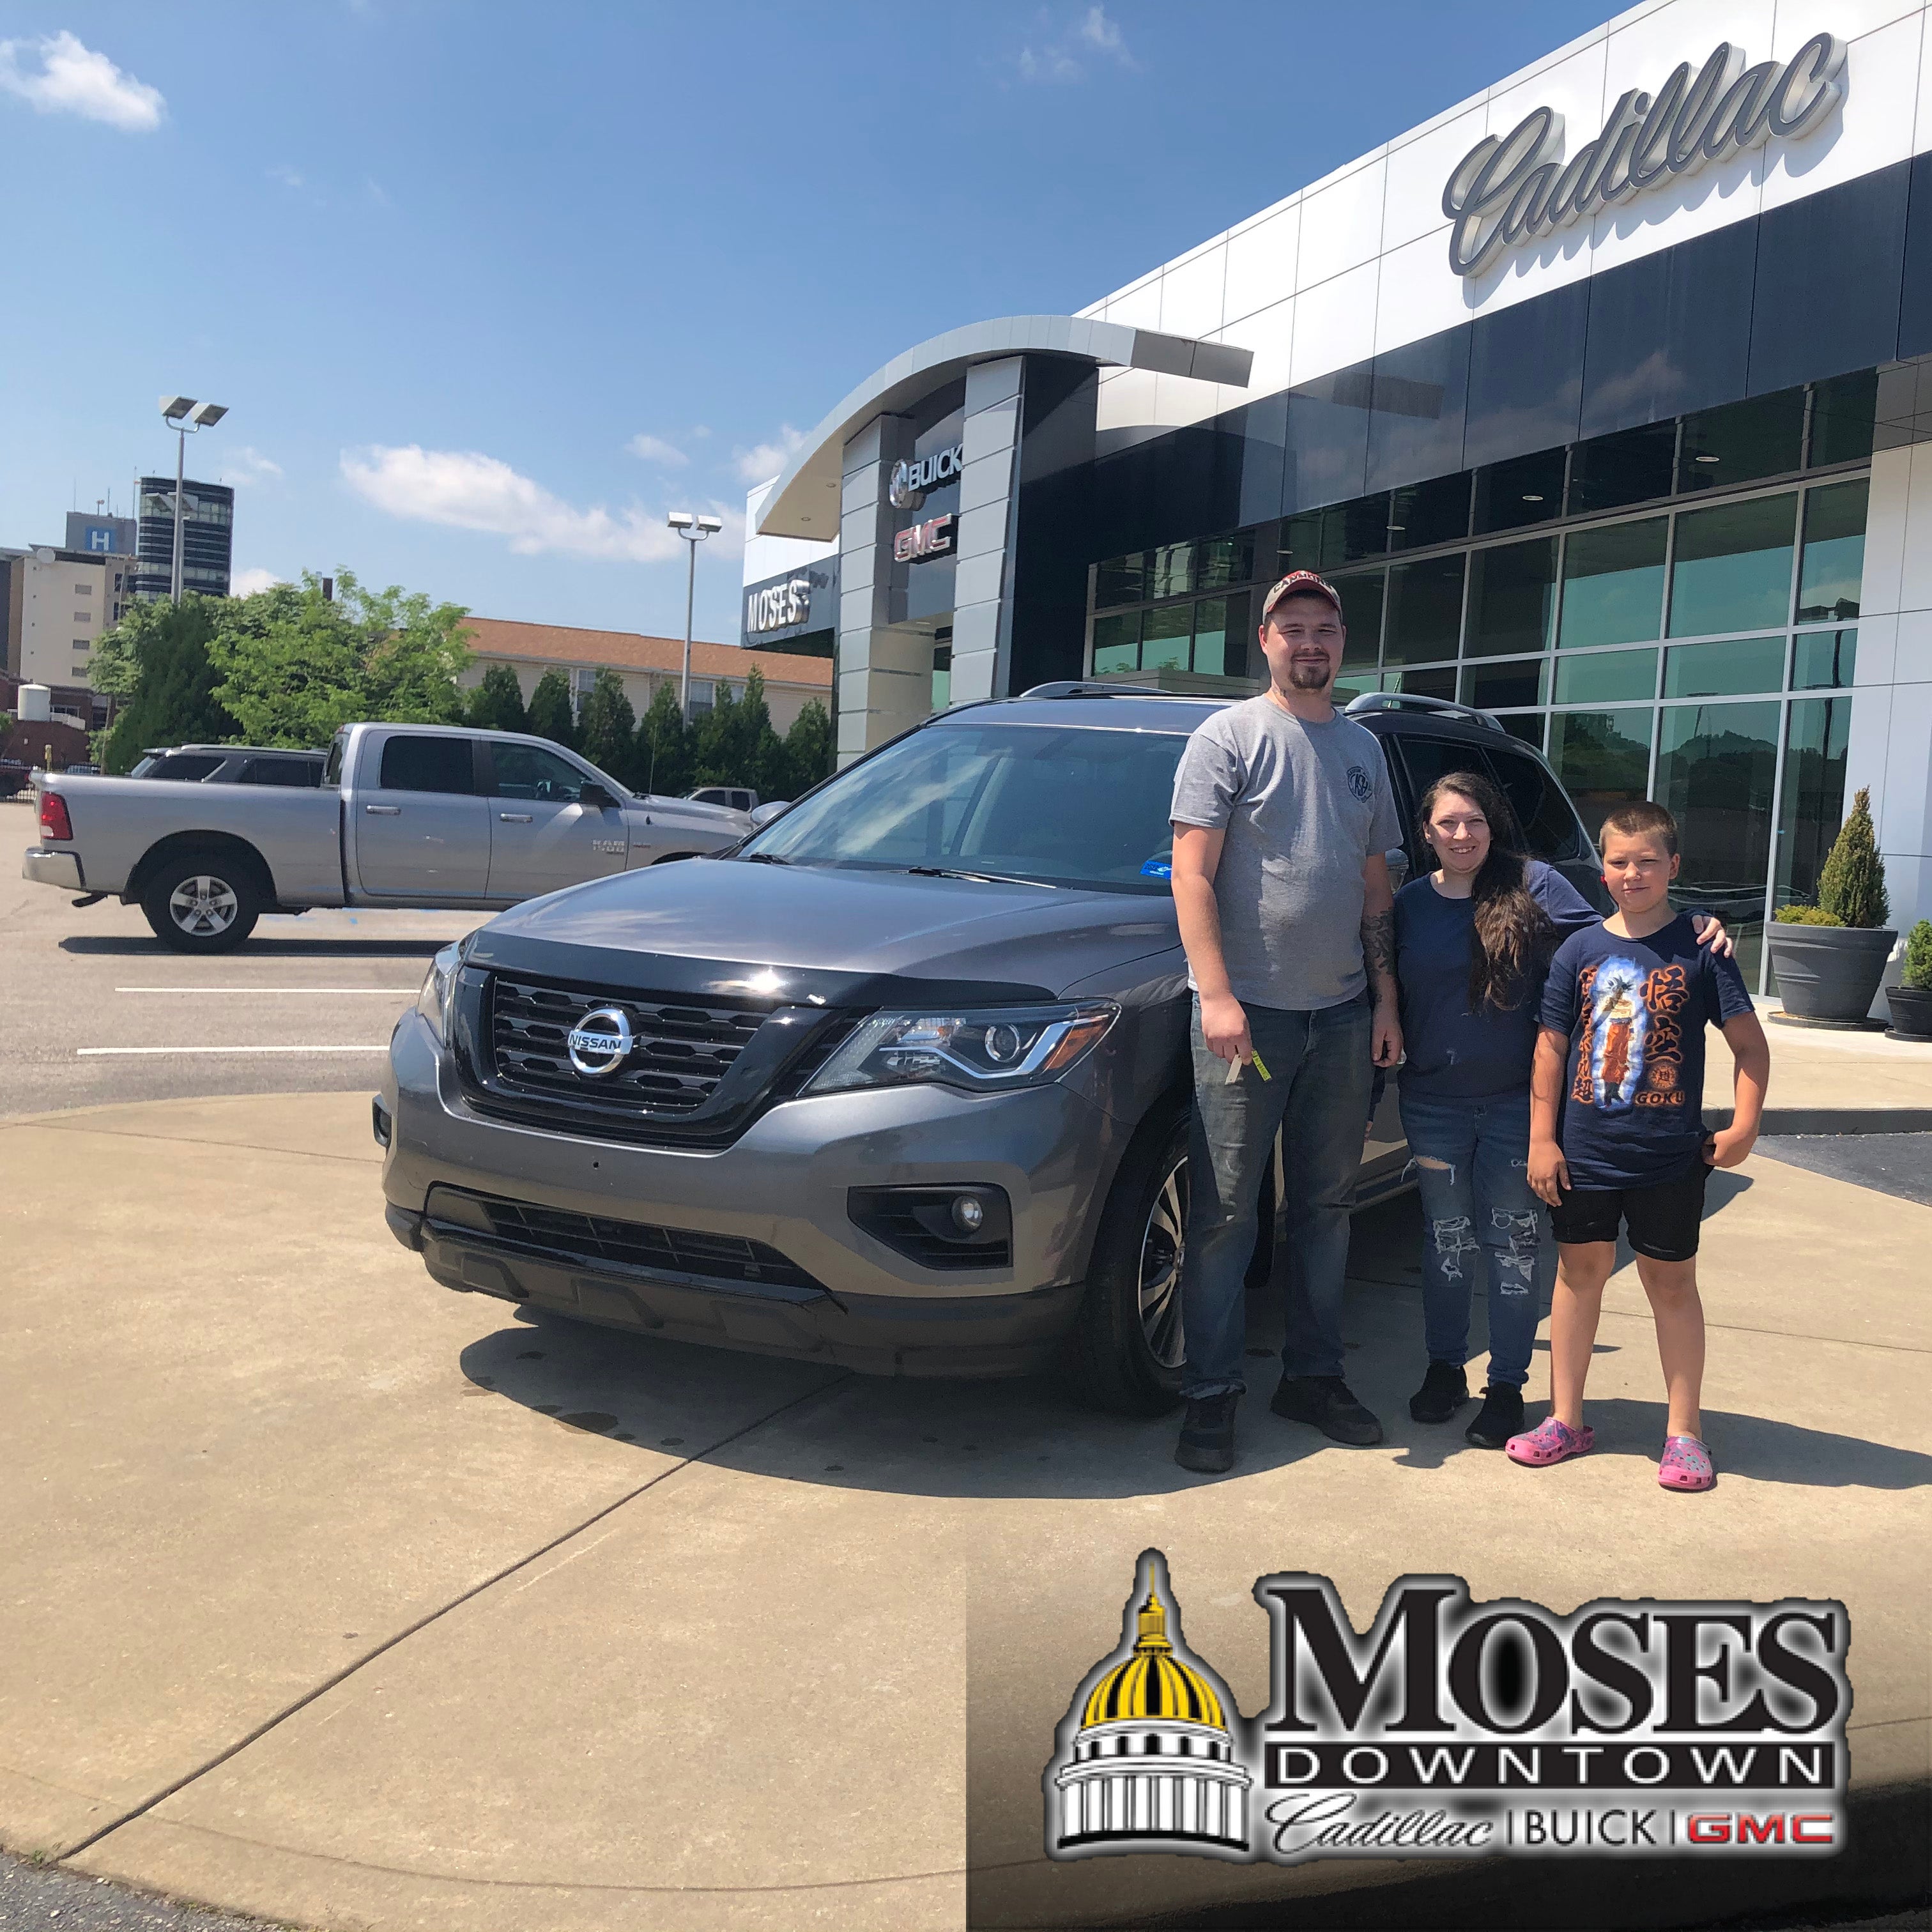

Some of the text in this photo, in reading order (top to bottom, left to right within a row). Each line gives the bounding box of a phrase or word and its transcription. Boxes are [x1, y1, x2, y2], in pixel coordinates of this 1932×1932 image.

[1442, 32, 1840, 277] Cadillac
[908, 445, 963, 492] BUICK
[91, 530, 109, 551] H
[894, 513, 953, 563] GMC
[747, 579, 804, 633] MOSES
[569, 1034, 622, 1050] NISSAN
[1636, 1091, 1684, 1105] GOKU
